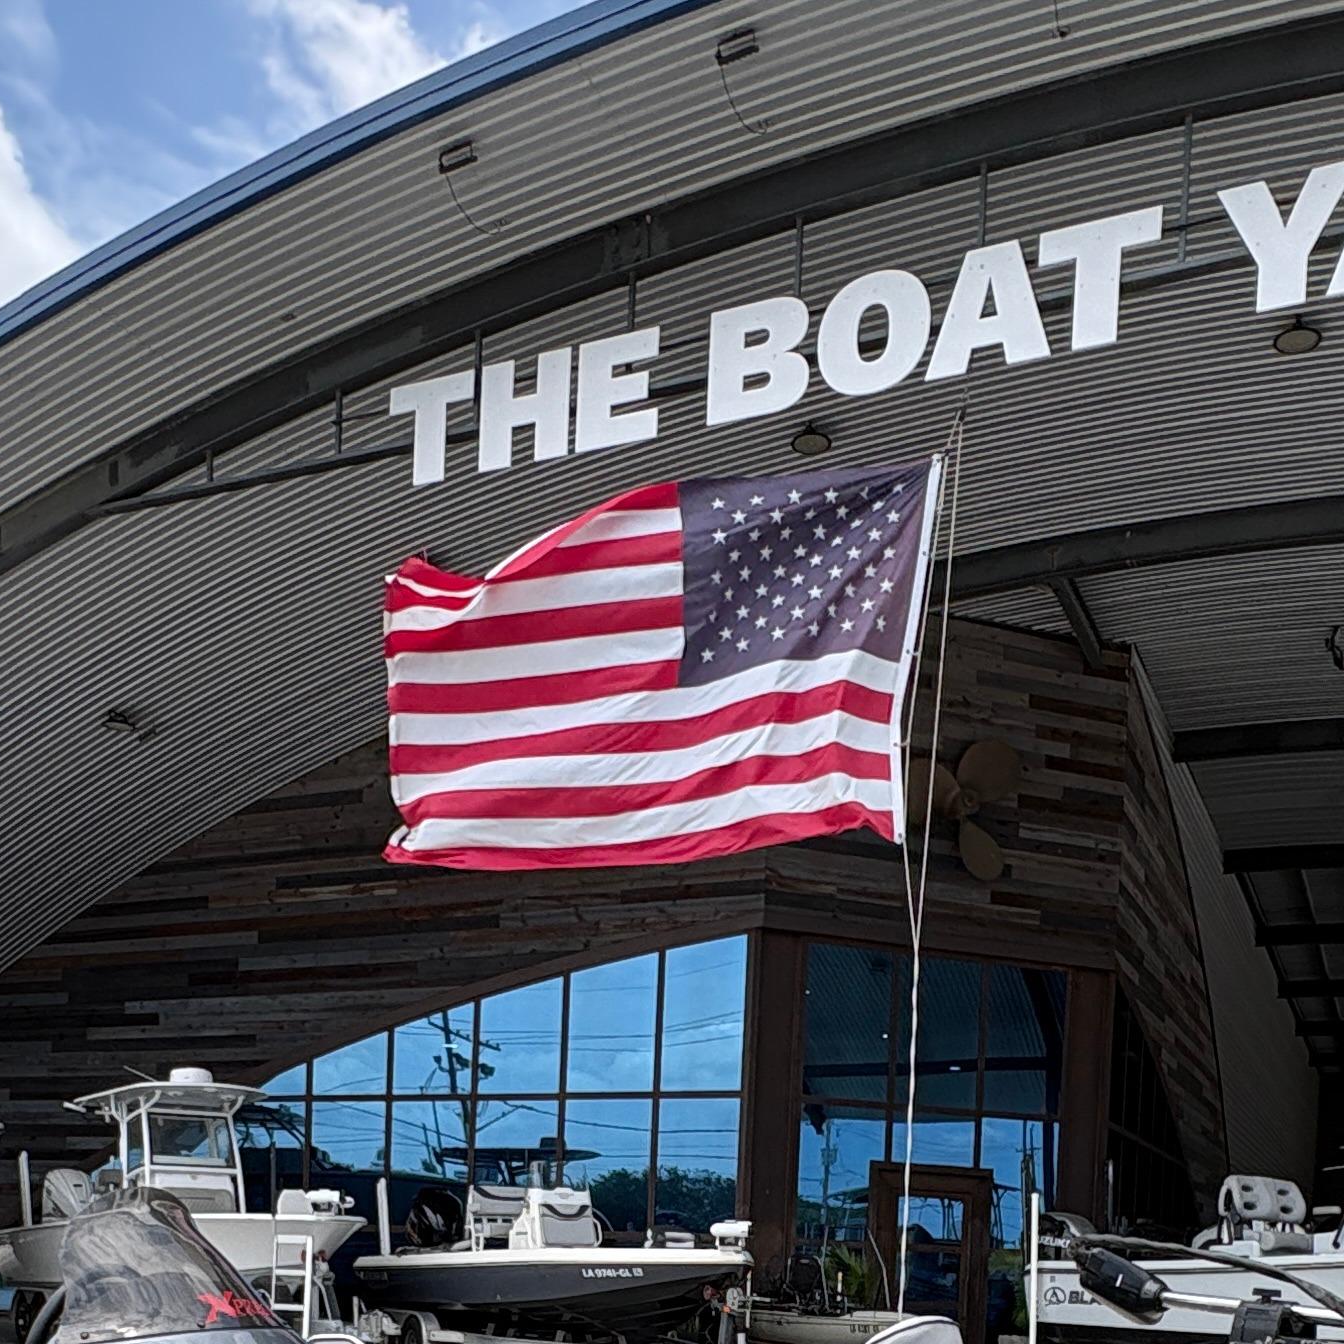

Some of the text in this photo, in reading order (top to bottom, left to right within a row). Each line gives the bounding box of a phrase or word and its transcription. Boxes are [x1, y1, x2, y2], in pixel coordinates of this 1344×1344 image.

[389, 327, 660, 486] THE
[706, 206, 1166, 426] BOAT
[581, 1268, 595, 1278] LA
